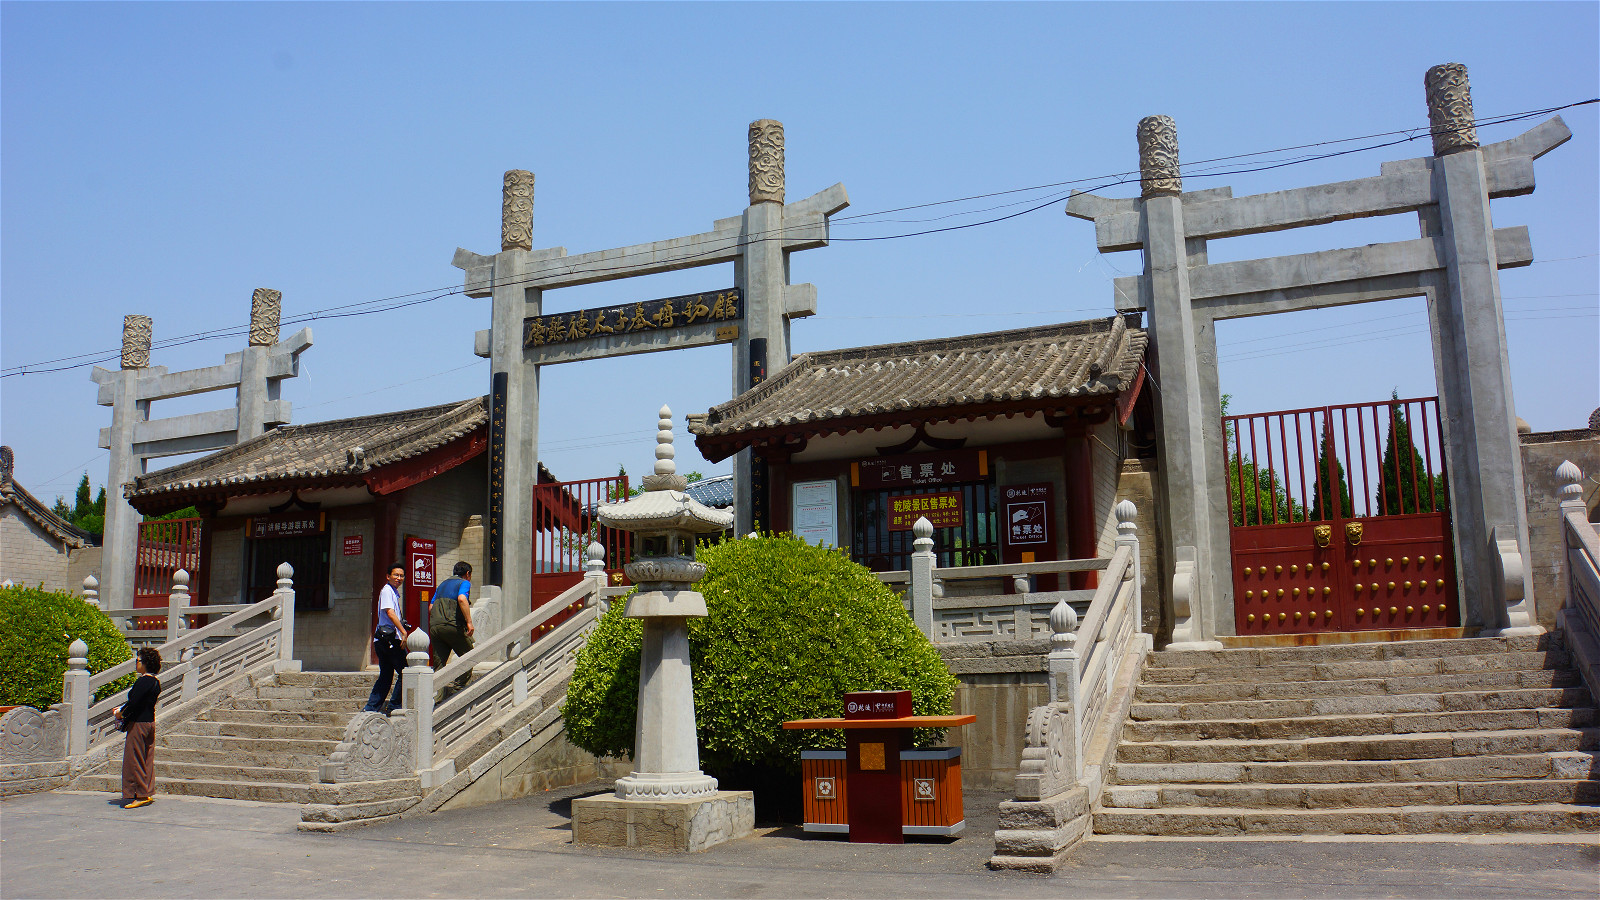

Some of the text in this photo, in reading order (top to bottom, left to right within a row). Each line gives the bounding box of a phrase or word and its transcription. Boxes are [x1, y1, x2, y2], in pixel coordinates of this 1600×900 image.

[899, 461, 956, 480] 售票处
[893, 496, 957, 512] 乾陵景区售票处
[1012, 523, 1043, 536] 售票处
